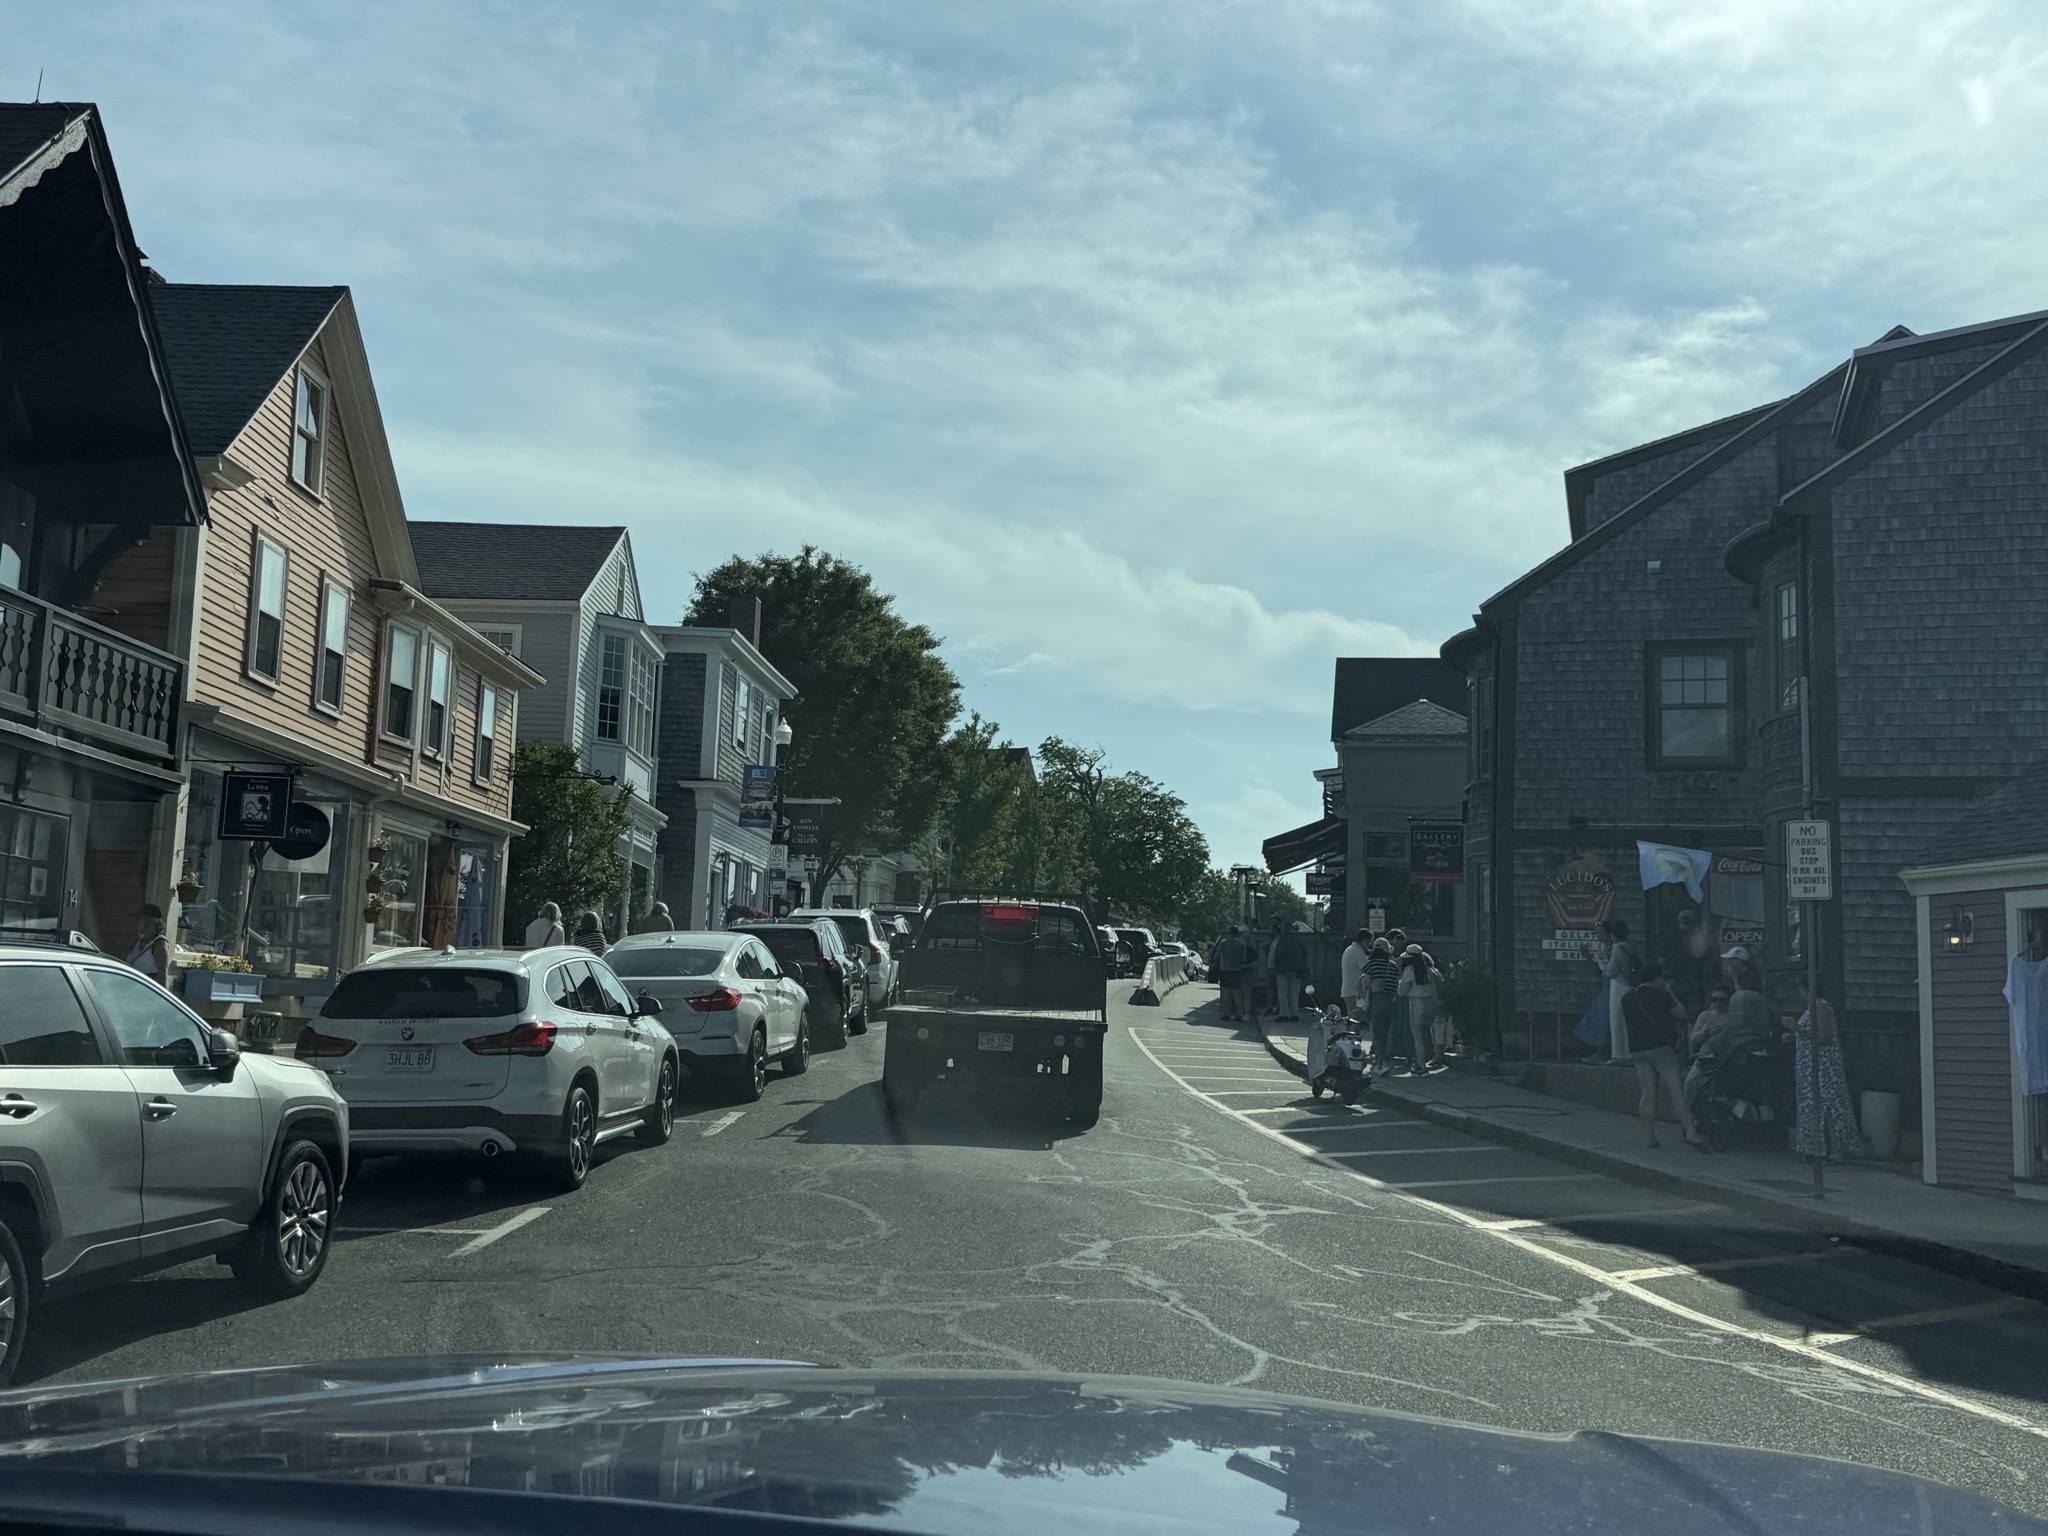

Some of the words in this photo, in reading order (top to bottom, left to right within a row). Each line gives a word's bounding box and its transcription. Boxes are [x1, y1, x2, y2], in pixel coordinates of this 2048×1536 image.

[1800, 826, 1816, 836] NO
[1791, 838, 1826, 846] PARKING
[1801, 847, 1816, 855] BUS
[1799, 857, 1819, 865] STOP
[1548, 871, 1613, 892] LUCIDO'S
[1793, 876, 1826, 884] ENGINES
[1803, 886, 1817, 894] OFF
[69, 888, 79, 909] 14
[1561, 931, 1597, 939] GELAT
[1723, 931, 1763, 942] OPEN
[1549, 941, 1593, 949] ITALIN
[387, 1053, 414, 1066] 3HJL
[417, 1052, 431, 1066] 88
